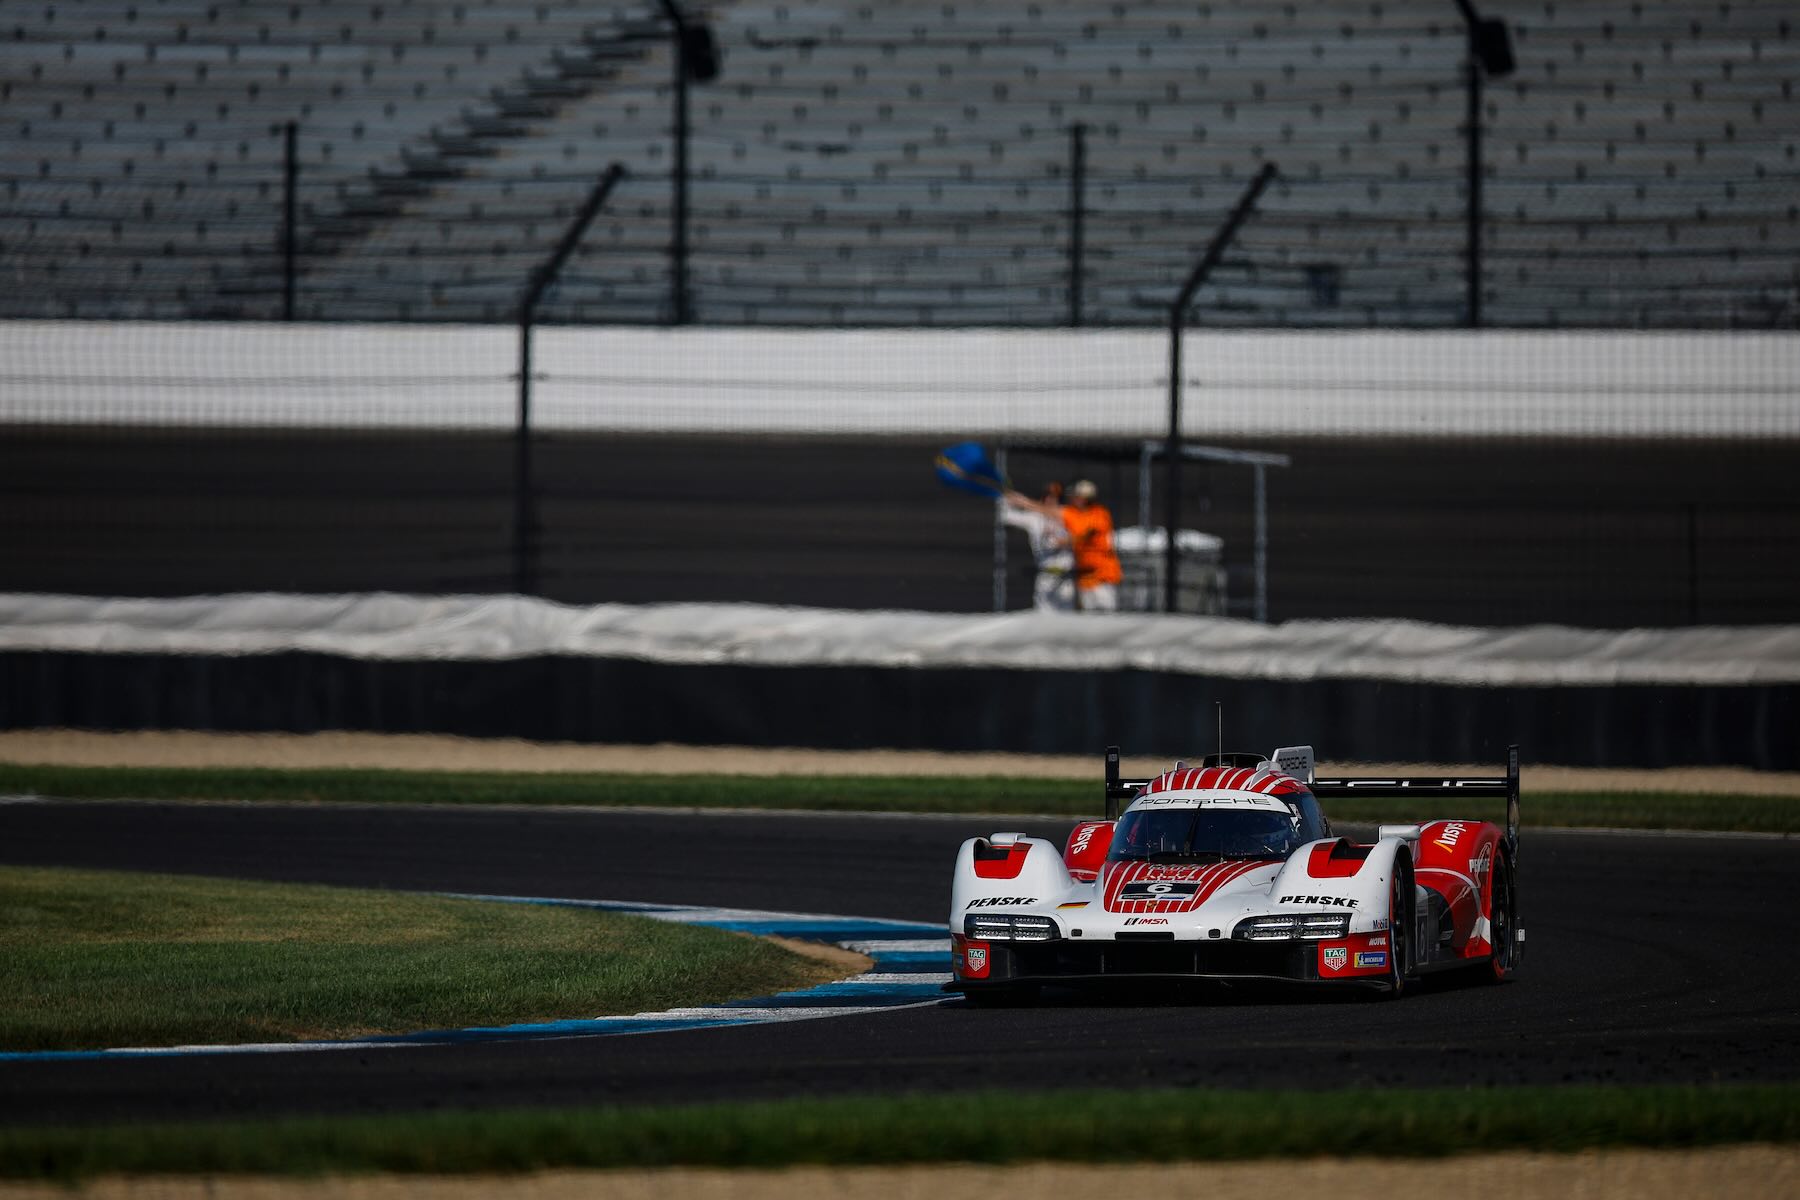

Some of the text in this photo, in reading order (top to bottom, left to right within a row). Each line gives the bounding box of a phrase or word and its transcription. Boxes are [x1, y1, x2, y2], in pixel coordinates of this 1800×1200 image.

[1279, 756, 1307, 769] PORSCHE
[1139, 798, 1272, 806] PORSCHE
[1433, 822, 1467, 854] Ansys
[1147, 883, 1174, 893] 6
[965, 897, 1039, 909] PENSKE
[1280, 895, 1360, 909] PENSKE
[969, 950, 985, 958] TAG
[1326, 949, 1345, 957] TAG
